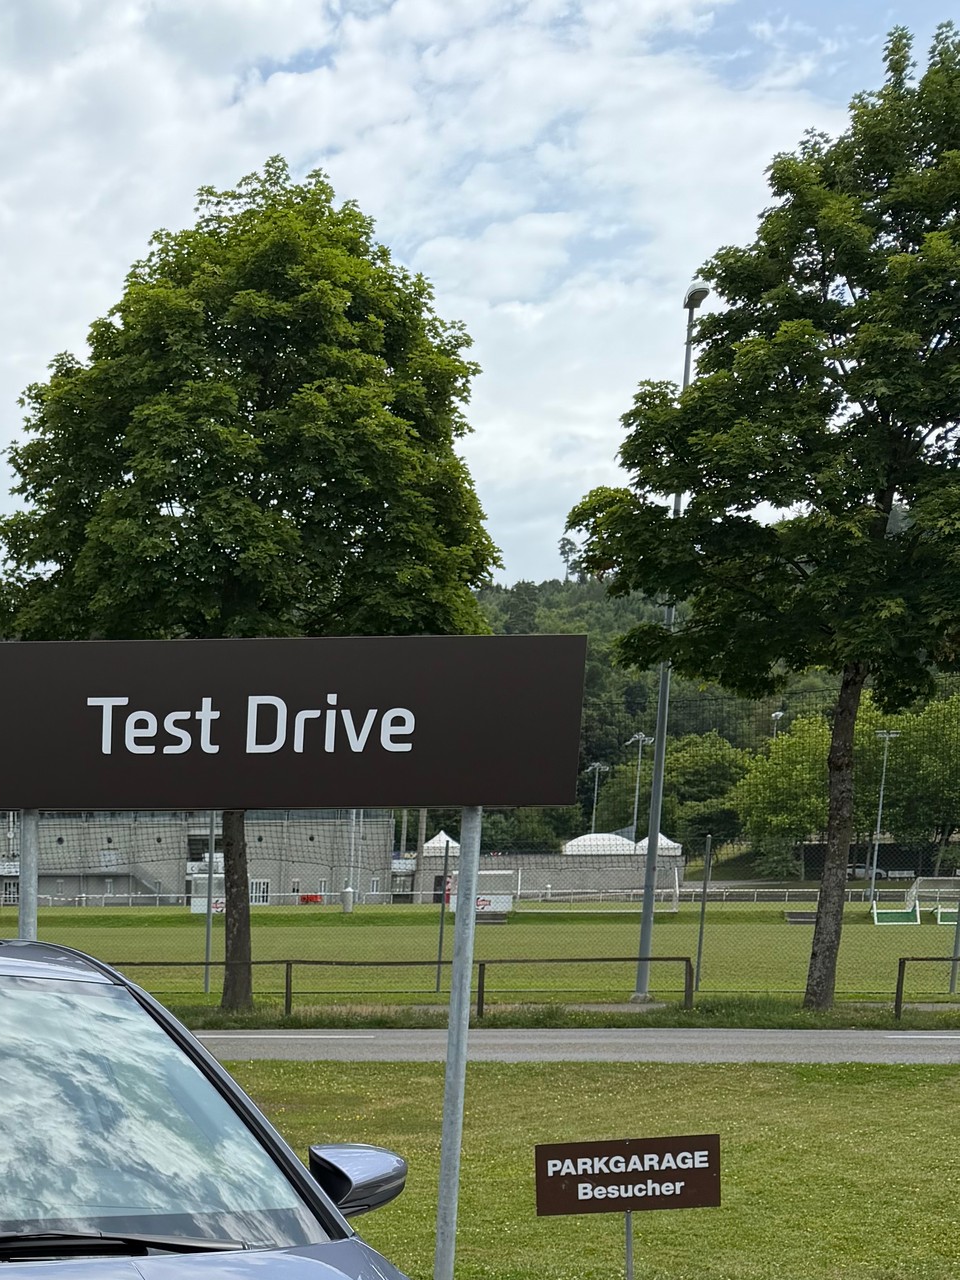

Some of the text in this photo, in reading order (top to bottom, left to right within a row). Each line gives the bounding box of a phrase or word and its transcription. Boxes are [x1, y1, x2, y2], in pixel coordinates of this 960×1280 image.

[87, 693, 416, 755] Test Drive
[547, 1150, 709, 1177] PARKGARAGE
[577, 1179, 685, 1200] Besucher
